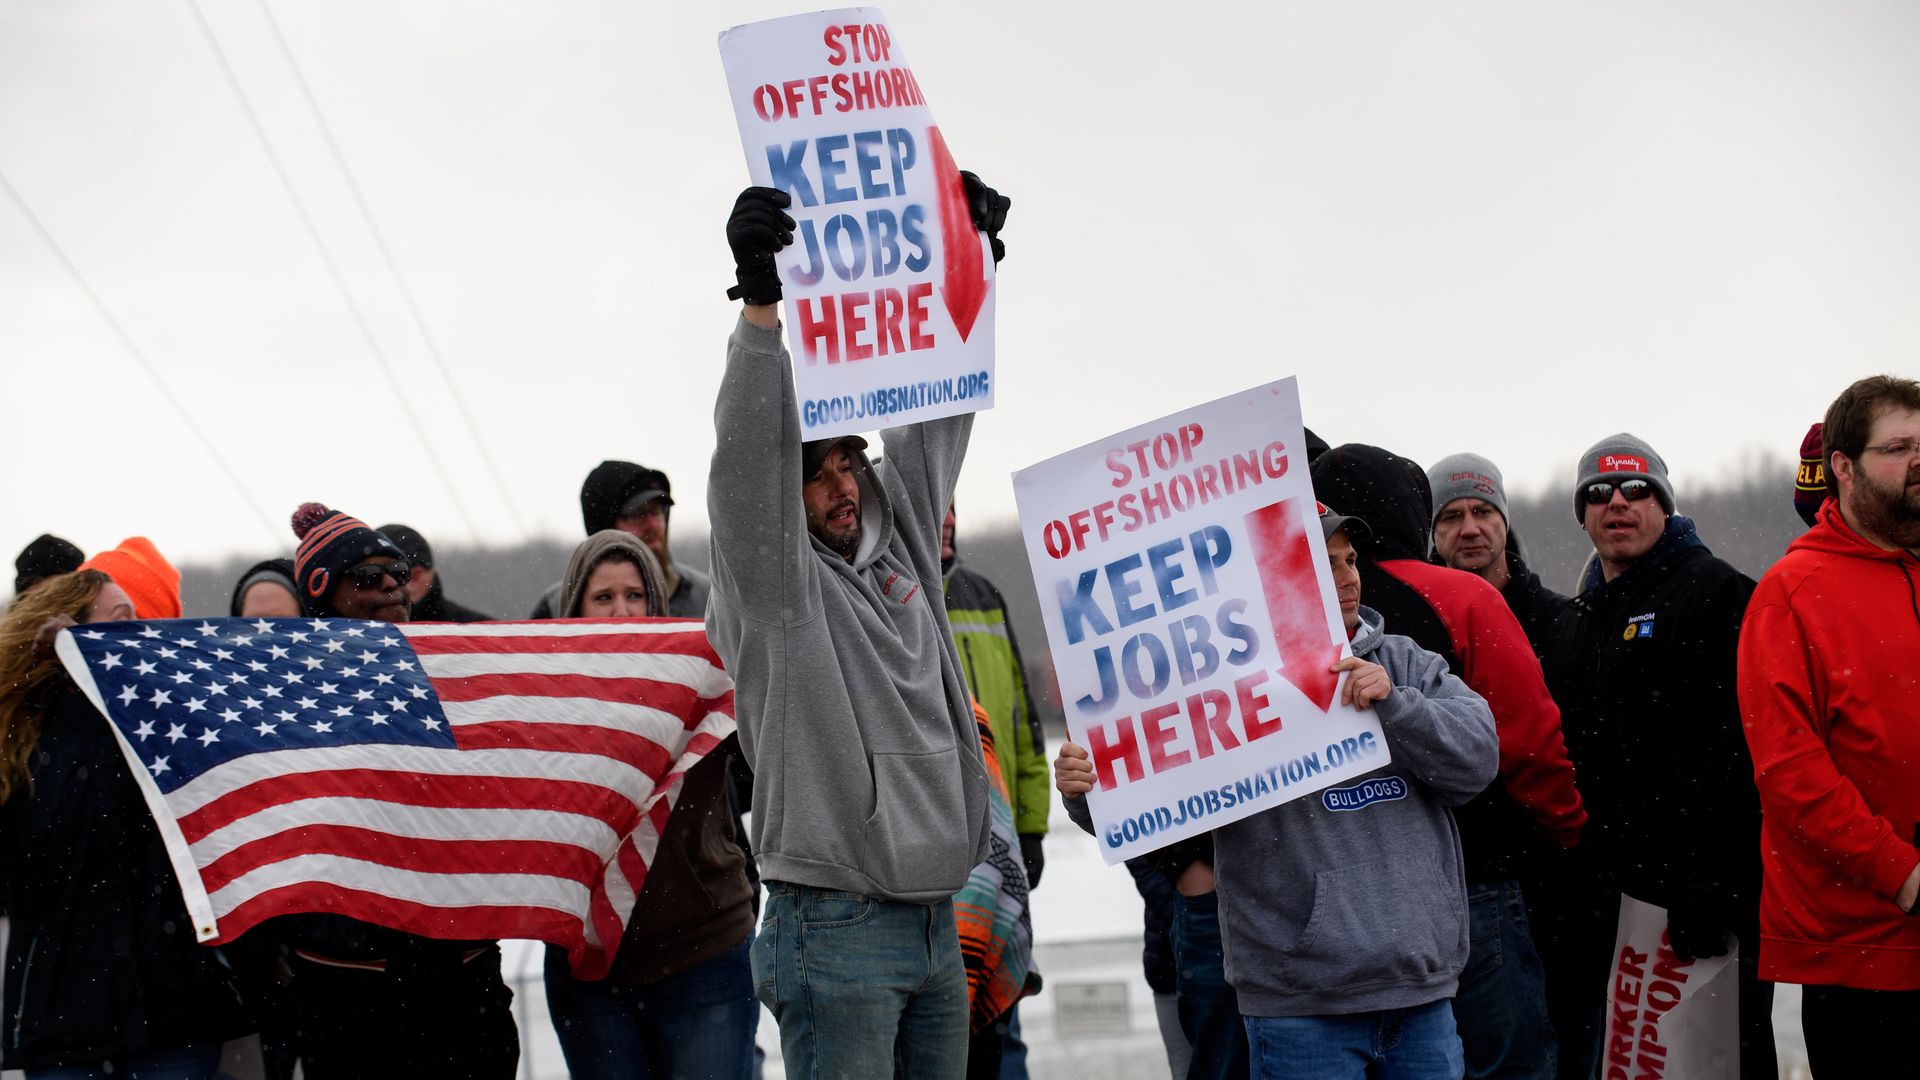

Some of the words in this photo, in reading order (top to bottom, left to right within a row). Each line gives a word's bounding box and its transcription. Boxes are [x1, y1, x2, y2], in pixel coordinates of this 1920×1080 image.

[823, 23, 890, 67] STOP
[765, 126, 917, 210] KEEP
[787, 203, 932, 288] JOBS
[796, 282, 936, 367] HERE
[803, 371, 989, 428] GOODJOBSNATION.ORG
[1105, 422, 1204, 489] STOP
[1605, 455, 1640, 471] Dynasty
[1043, 441, 1289, 560] OFFSHORING
[1056, 524, 1233, 645] KEEP
[1075, 597, 1260, 717] JOBS
[1087, 670, 1283, 792] HERE
[1104, 730, 1378, 849] GOODJOBSNATION.ORG
[1328, 781, 1401, 807] BULLDOGS
